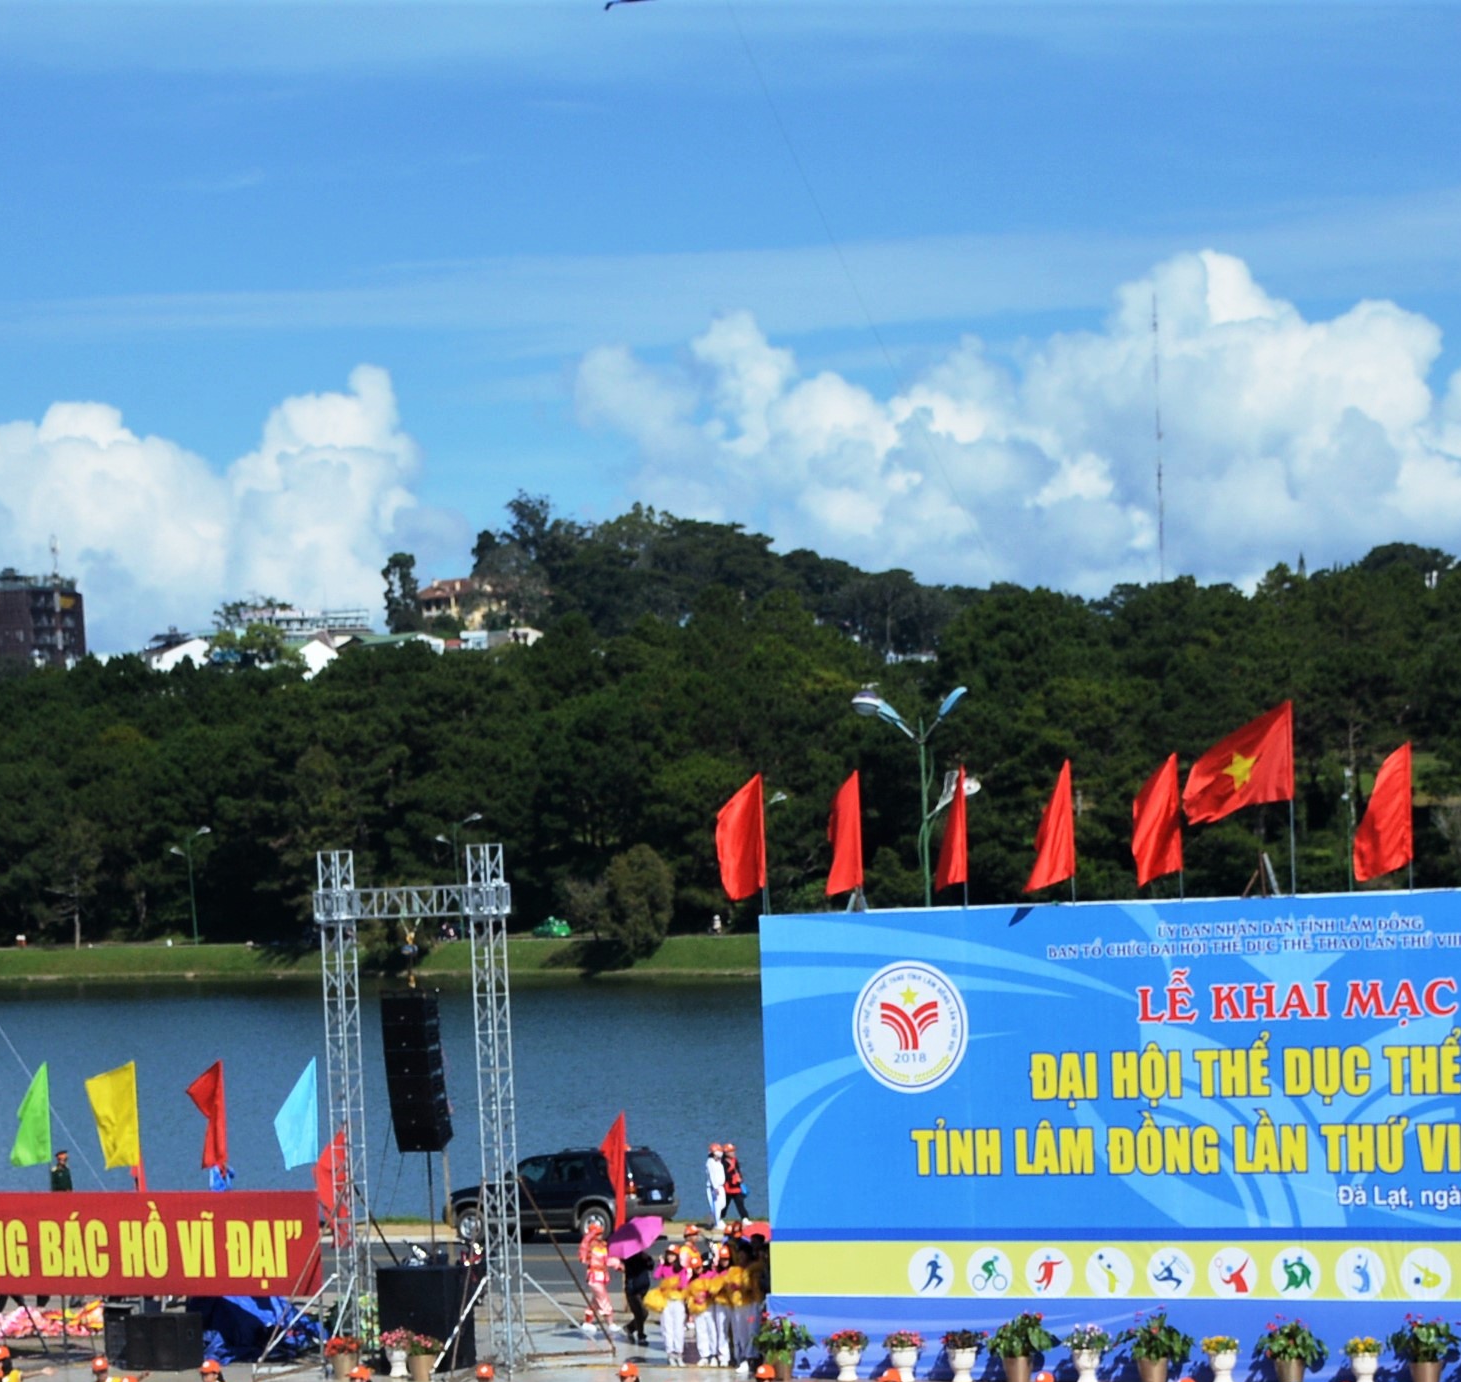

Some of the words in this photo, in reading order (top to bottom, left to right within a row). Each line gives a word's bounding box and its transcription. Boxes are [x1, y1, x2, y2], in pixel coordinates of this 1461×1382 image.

[1181, 922, 1211, 938] BAN
[1215, 918, 1258, 937] NHÂN
[1262, 917, 1295, 936] DÂN
[1339, 914, 1374, 932] LÂM
[1377, 911, 1424, 931] ĐỒNG
[1047, 944, 1079, 960] BAN
[1317, 934, 1361, 950] THAO
[1136, 968, 1198, 1024] LỄ
[1209, 979, 1329, 1022] KHAI
[1342, 976, 1459, 1028] MẠC
[893, 1052, 928, 1064] 2018
[1029, 1050, 1099, 1109] ĐẠI
[1110, 1041, 1183, 1108] HỘI
[1193, 1031, 1272, 1099] THỂ
[1282, 1045, 1371, 1105] DỤC
[910, 1117, 1002, 1176] TỈNH
[1013, 1119, 1095, 1176] LÂM
[1106, 1110, 1221, 1176] ĐỒNG
[1232, 1108, 1309, 1175] LẦN
[1320, 1115, 1409, 1174] THỨ
[1336, 1184, 1367, 1206] Đà
[1372, 1184, 1415, 1209] Lạt,
[41, 1210, 111, 1278] BÁC
[119, 1201, 168, 1278] HỒ
[175, 1211, 217, 1278] VĨ
[225, 1219, 303, 1289] ĐẠI”
